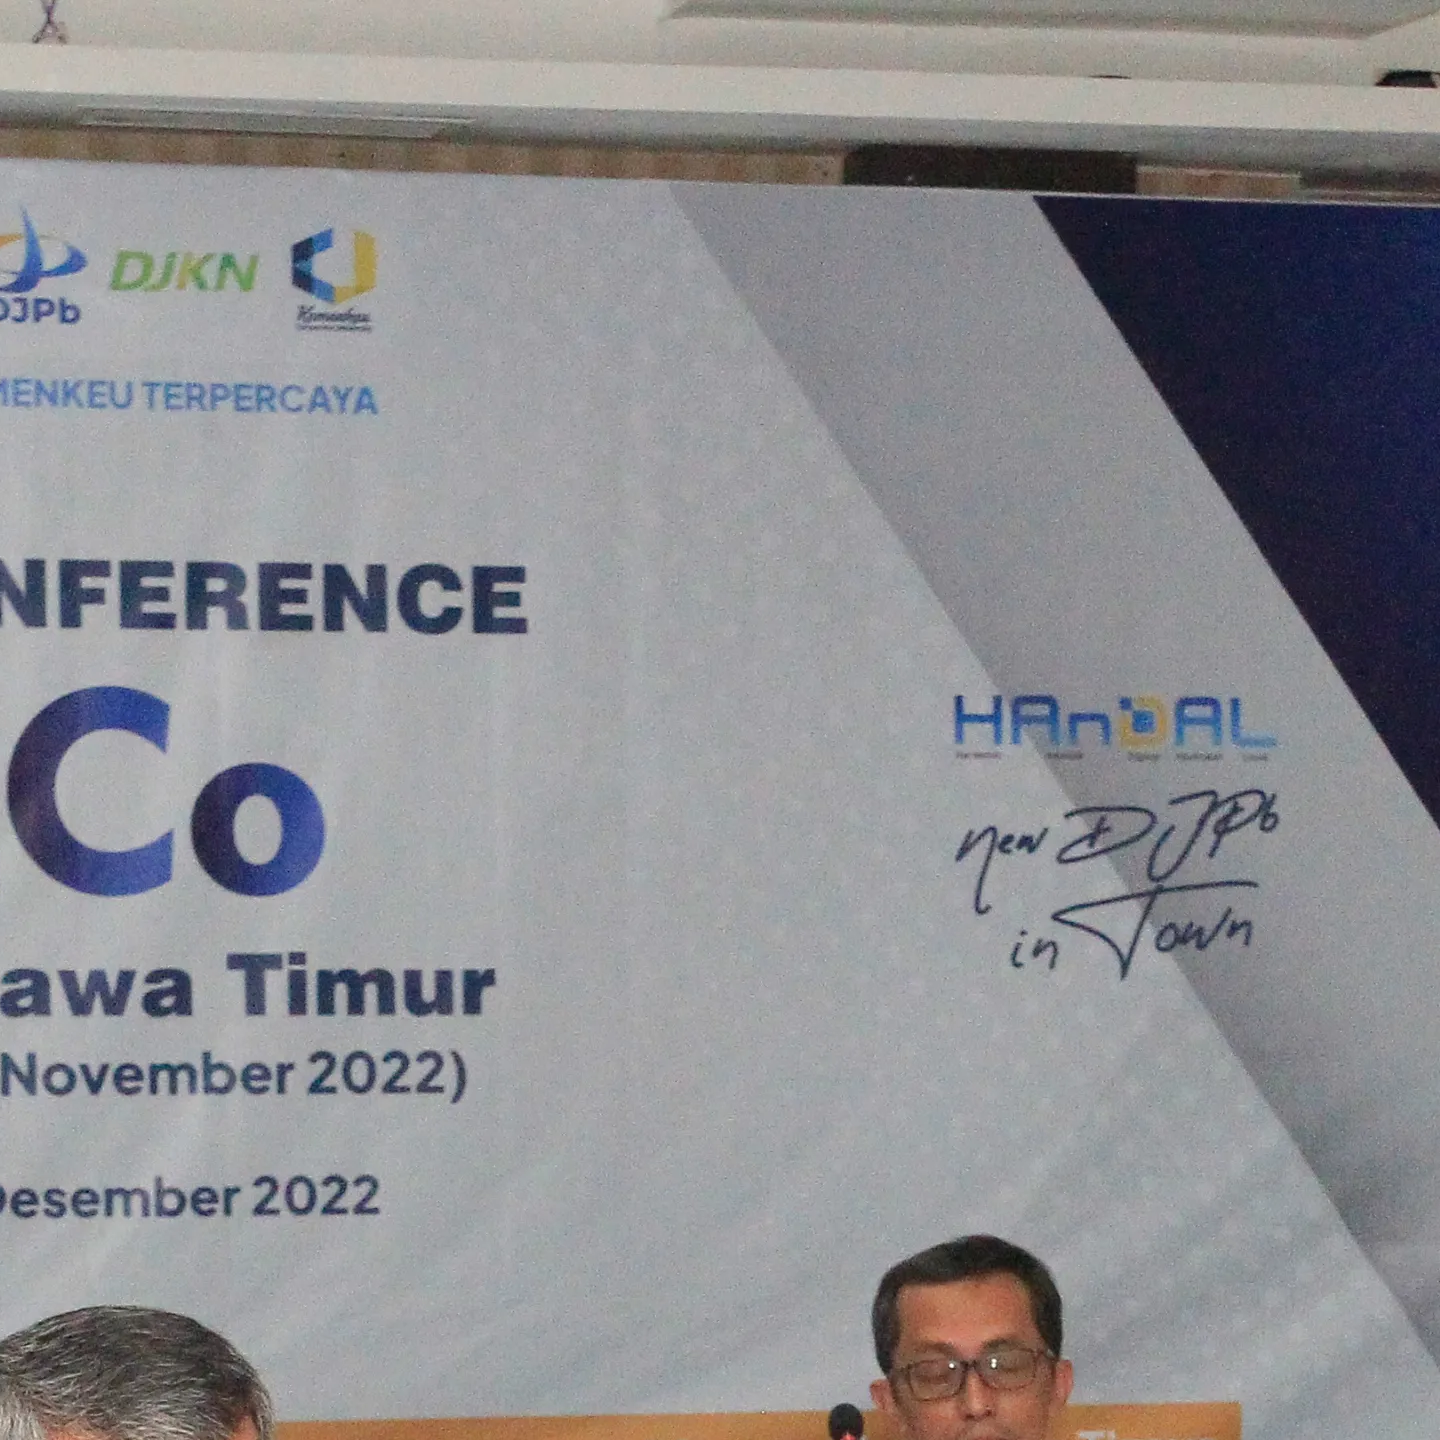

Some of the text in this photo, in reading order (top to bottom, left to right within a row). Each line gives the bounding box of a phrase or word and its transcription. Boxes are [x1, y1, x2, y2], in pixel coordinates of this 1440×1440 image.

[110, 251, 259, 292] DJKN
[142, 381, 379, 415] TERPERCAYA
[1011, 930, 1059, 970] in
[227, 952, 496, 1017] Timur
[0, 1051, 295, 1097] November
[307, 1049, 467, 1104] 2022)
[252, 1174, 380, 1216] 2022
